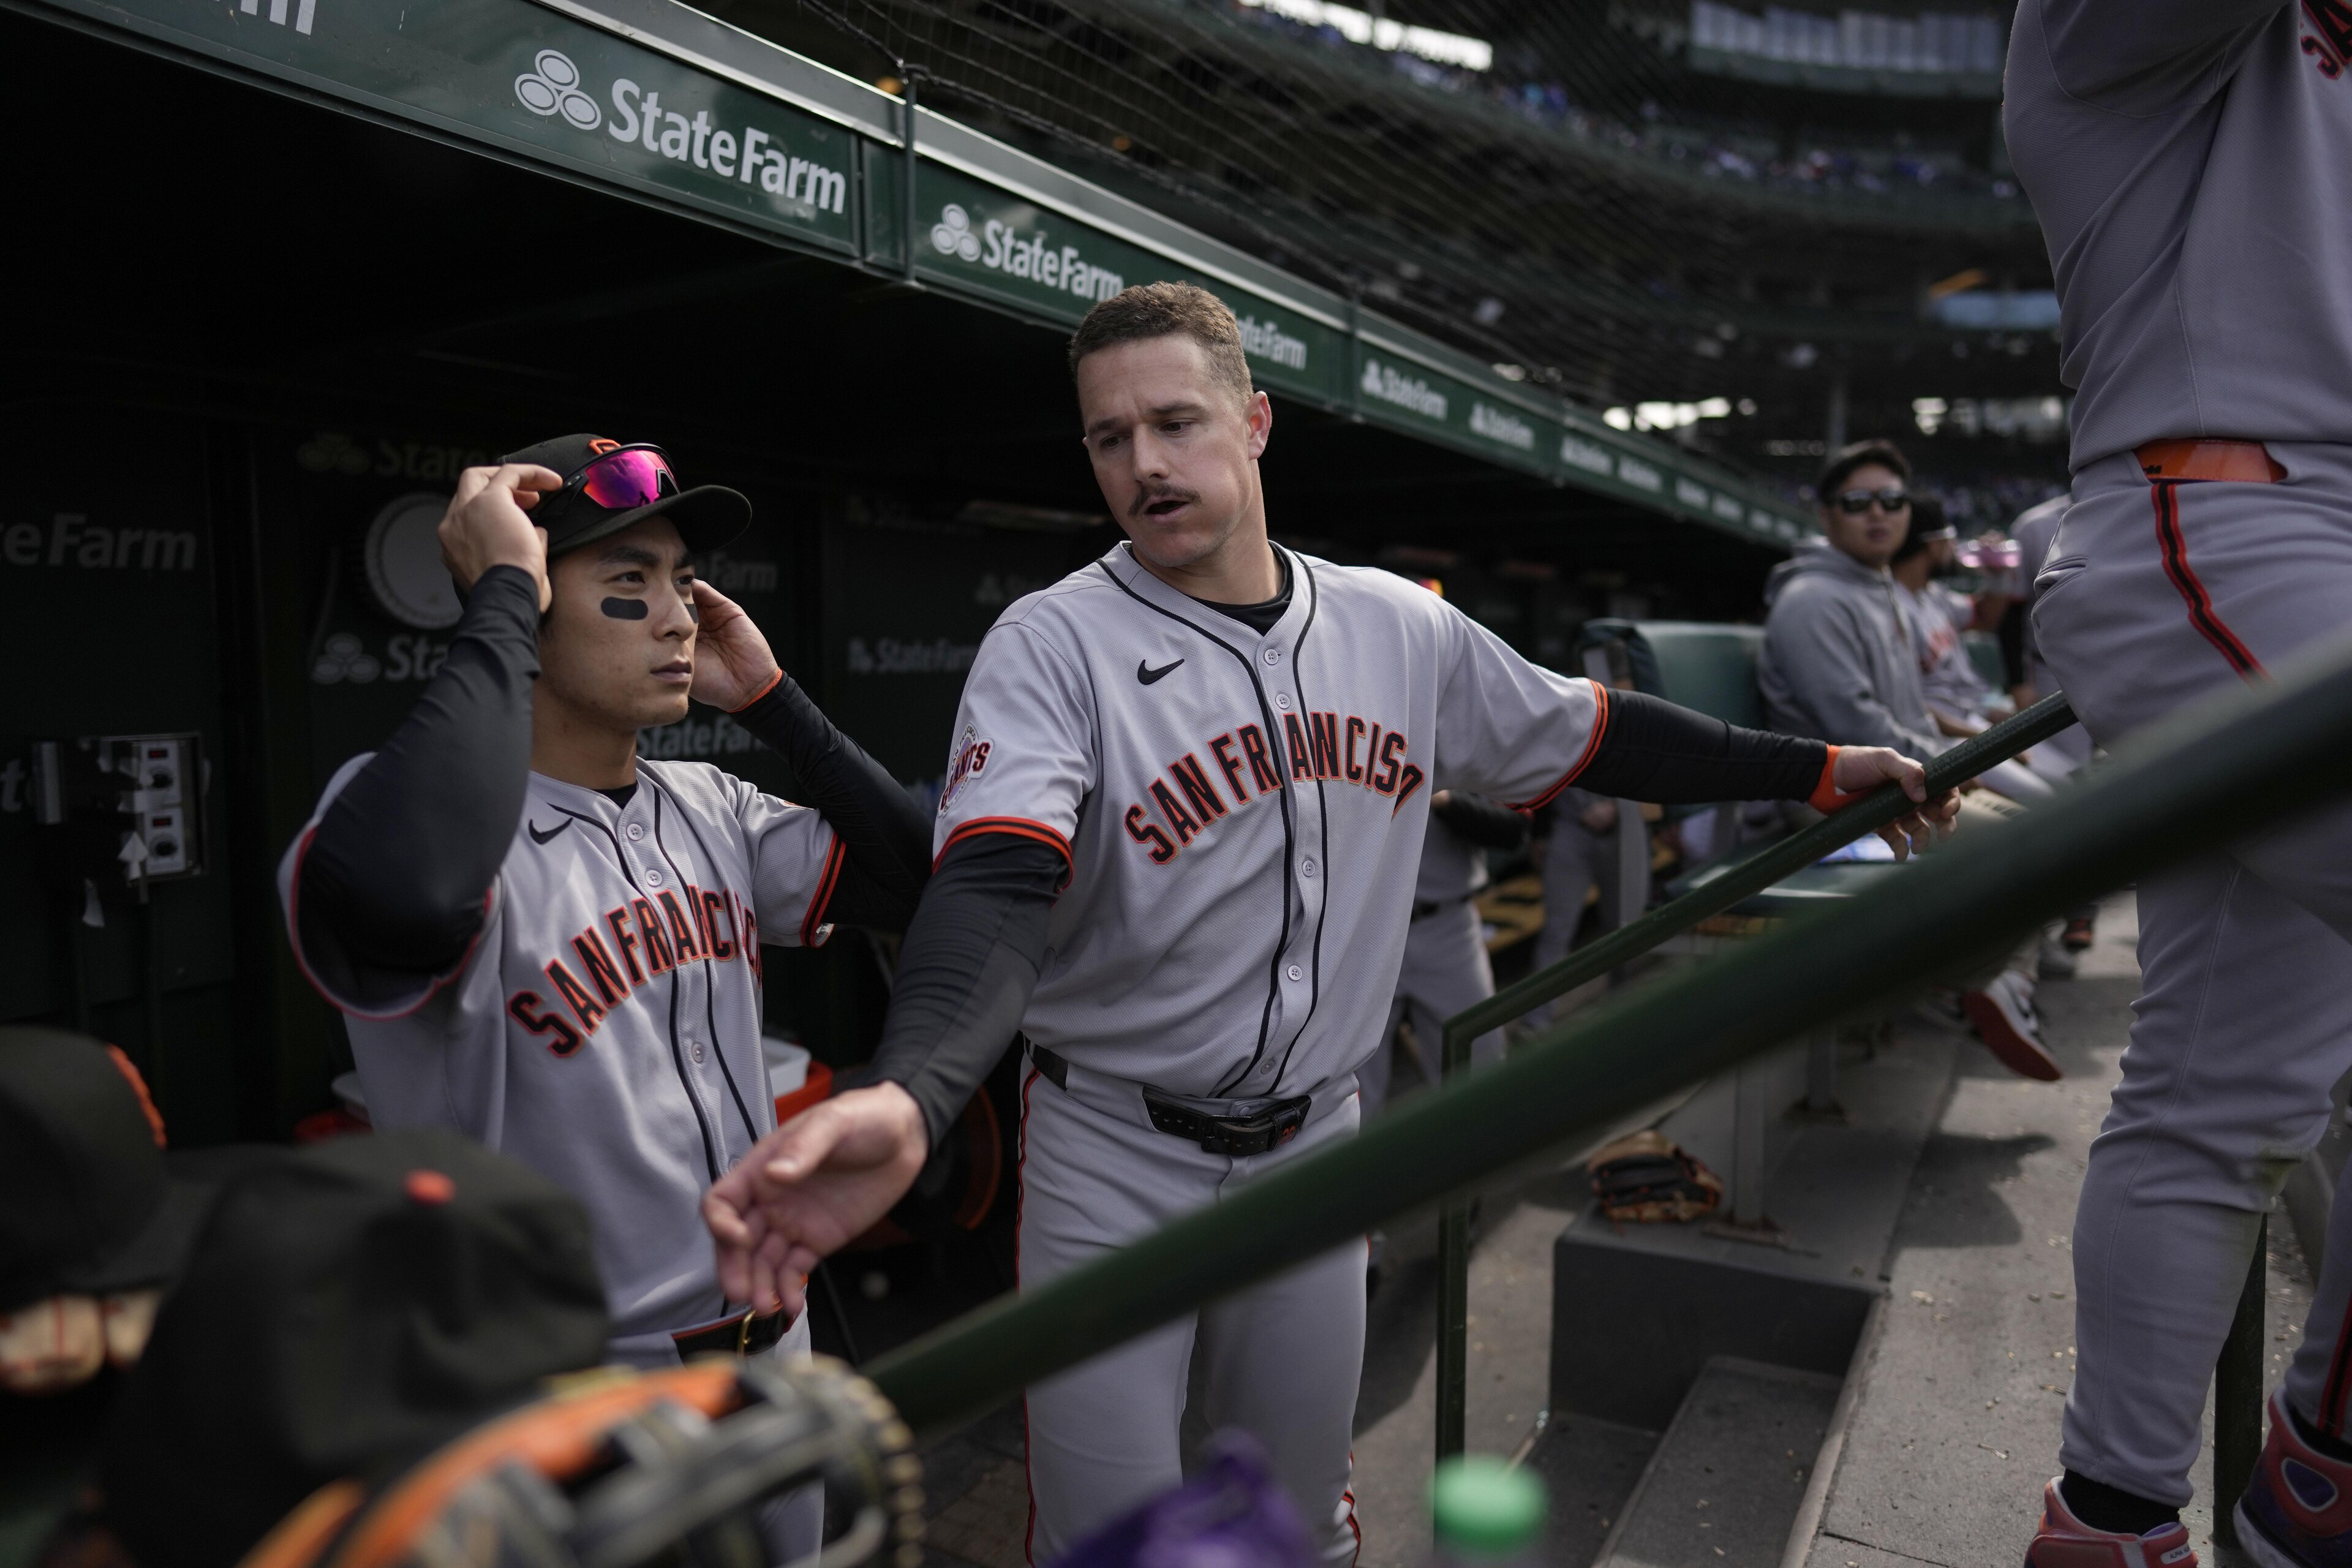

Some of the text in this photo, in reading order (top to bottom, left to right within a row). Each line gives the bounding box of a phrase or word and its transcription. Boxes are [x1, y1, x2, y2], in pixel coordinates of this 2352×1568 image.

[608, 78, 846, 214] StateFarm
[0, 512, 197, 571] eFarm
[1125, 752, 1230, 865] SAN
[507, 925, 631, 1058] SAN
